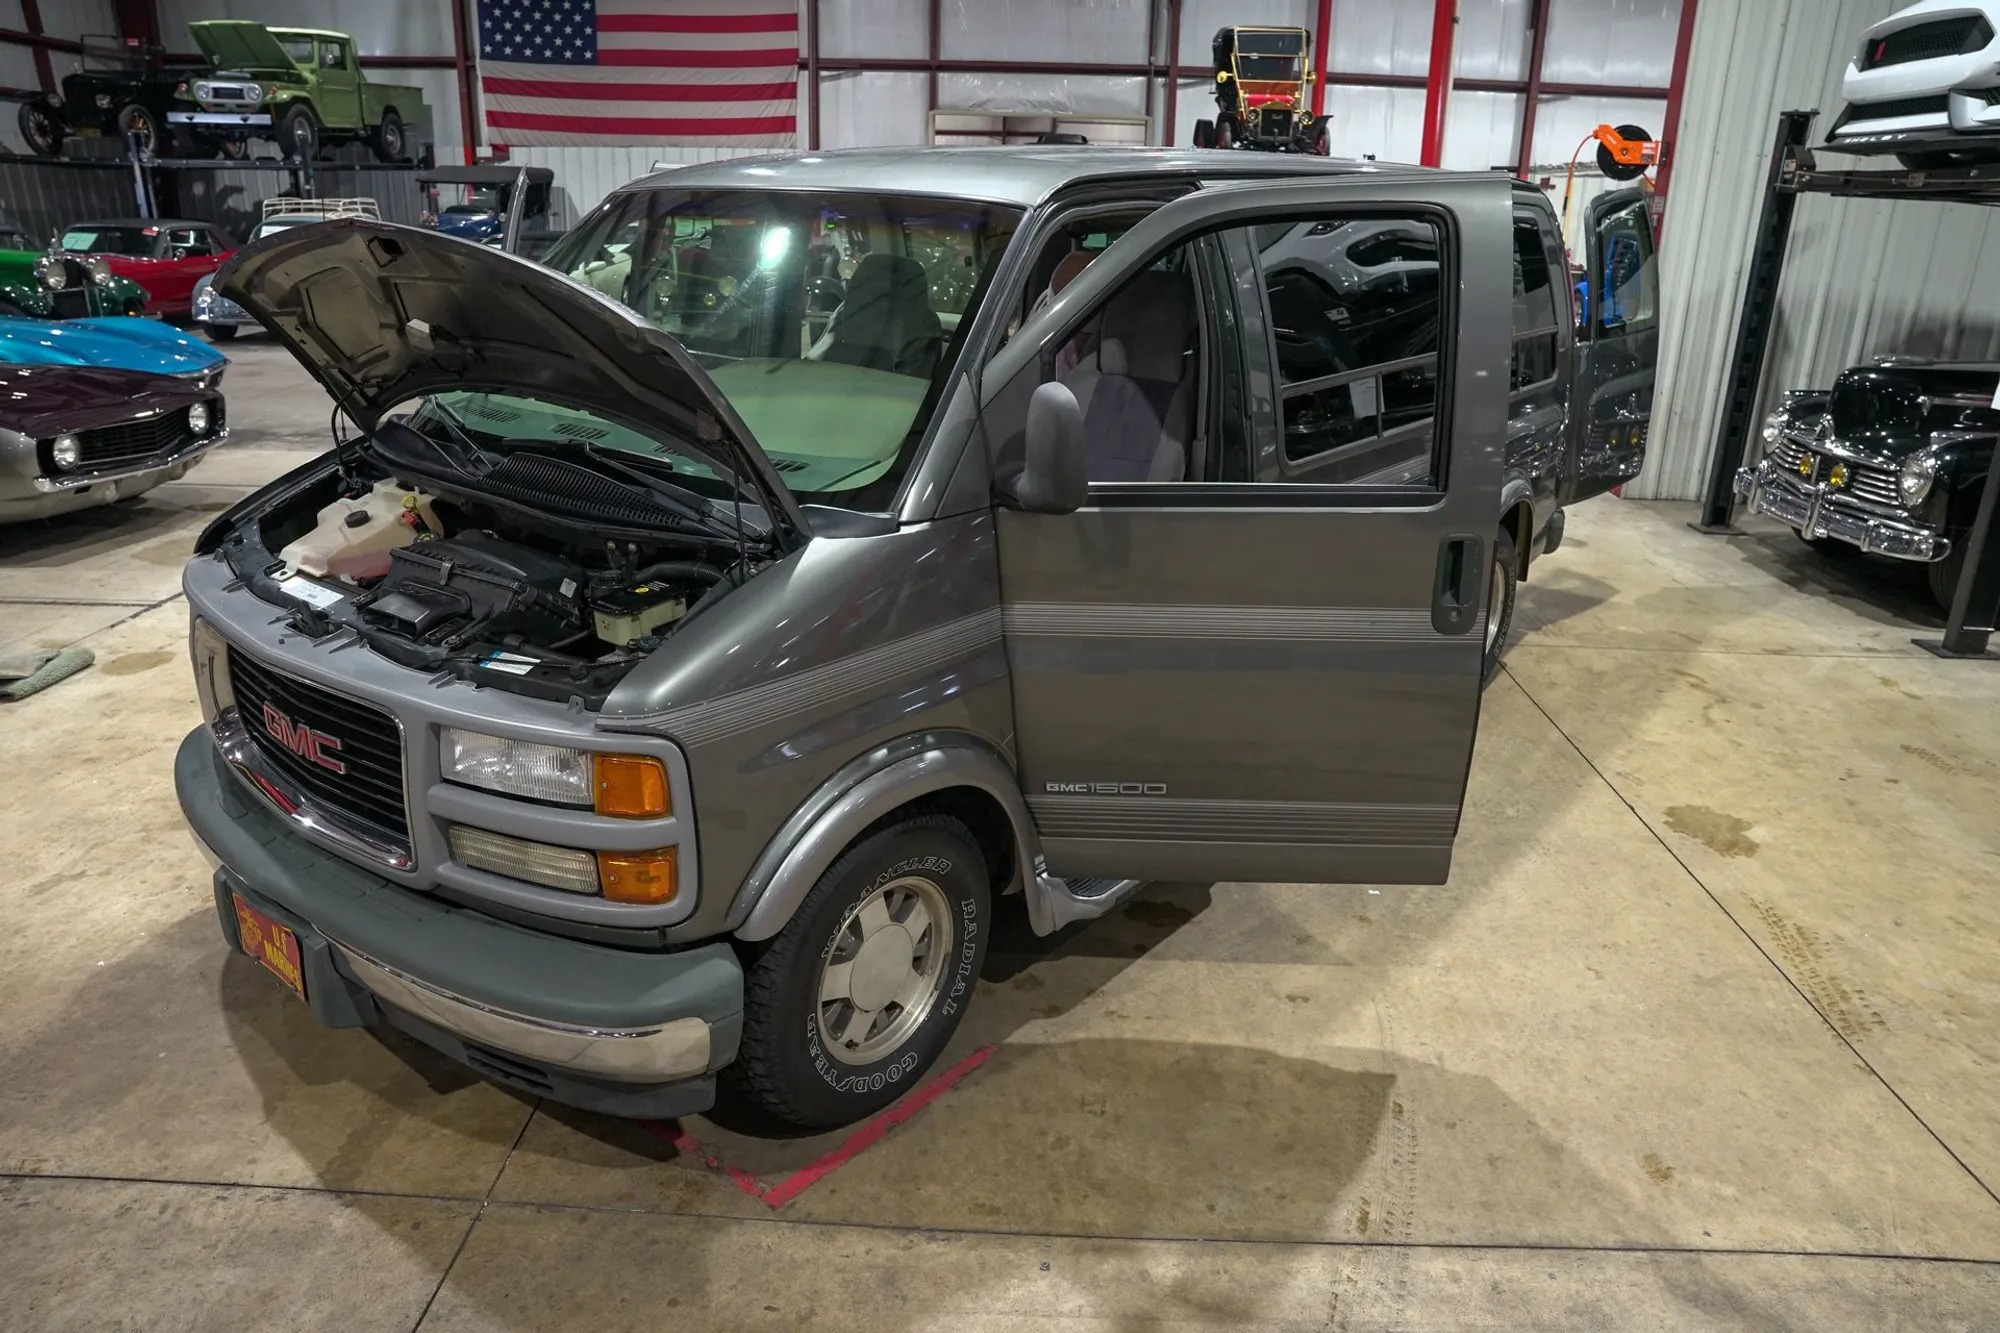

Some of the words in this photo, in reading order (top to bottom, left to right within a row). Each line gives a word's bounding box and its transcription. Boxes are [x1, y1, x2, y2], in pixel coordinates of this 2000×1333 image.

[1843, 134, 1907, 144] SHELBY
[263, 700, 345, 774] GMC
[1045, 781, 1087, 793] GMC
[1087, 782, 1168, 795] 1500
[821, 856, 952, 960] WRANGLER
[263, 939, 301, 991] MARINES
[942, 899, 978, 1015] RADIAL
[807, 1013, 918, 1093] GOODYEAR
